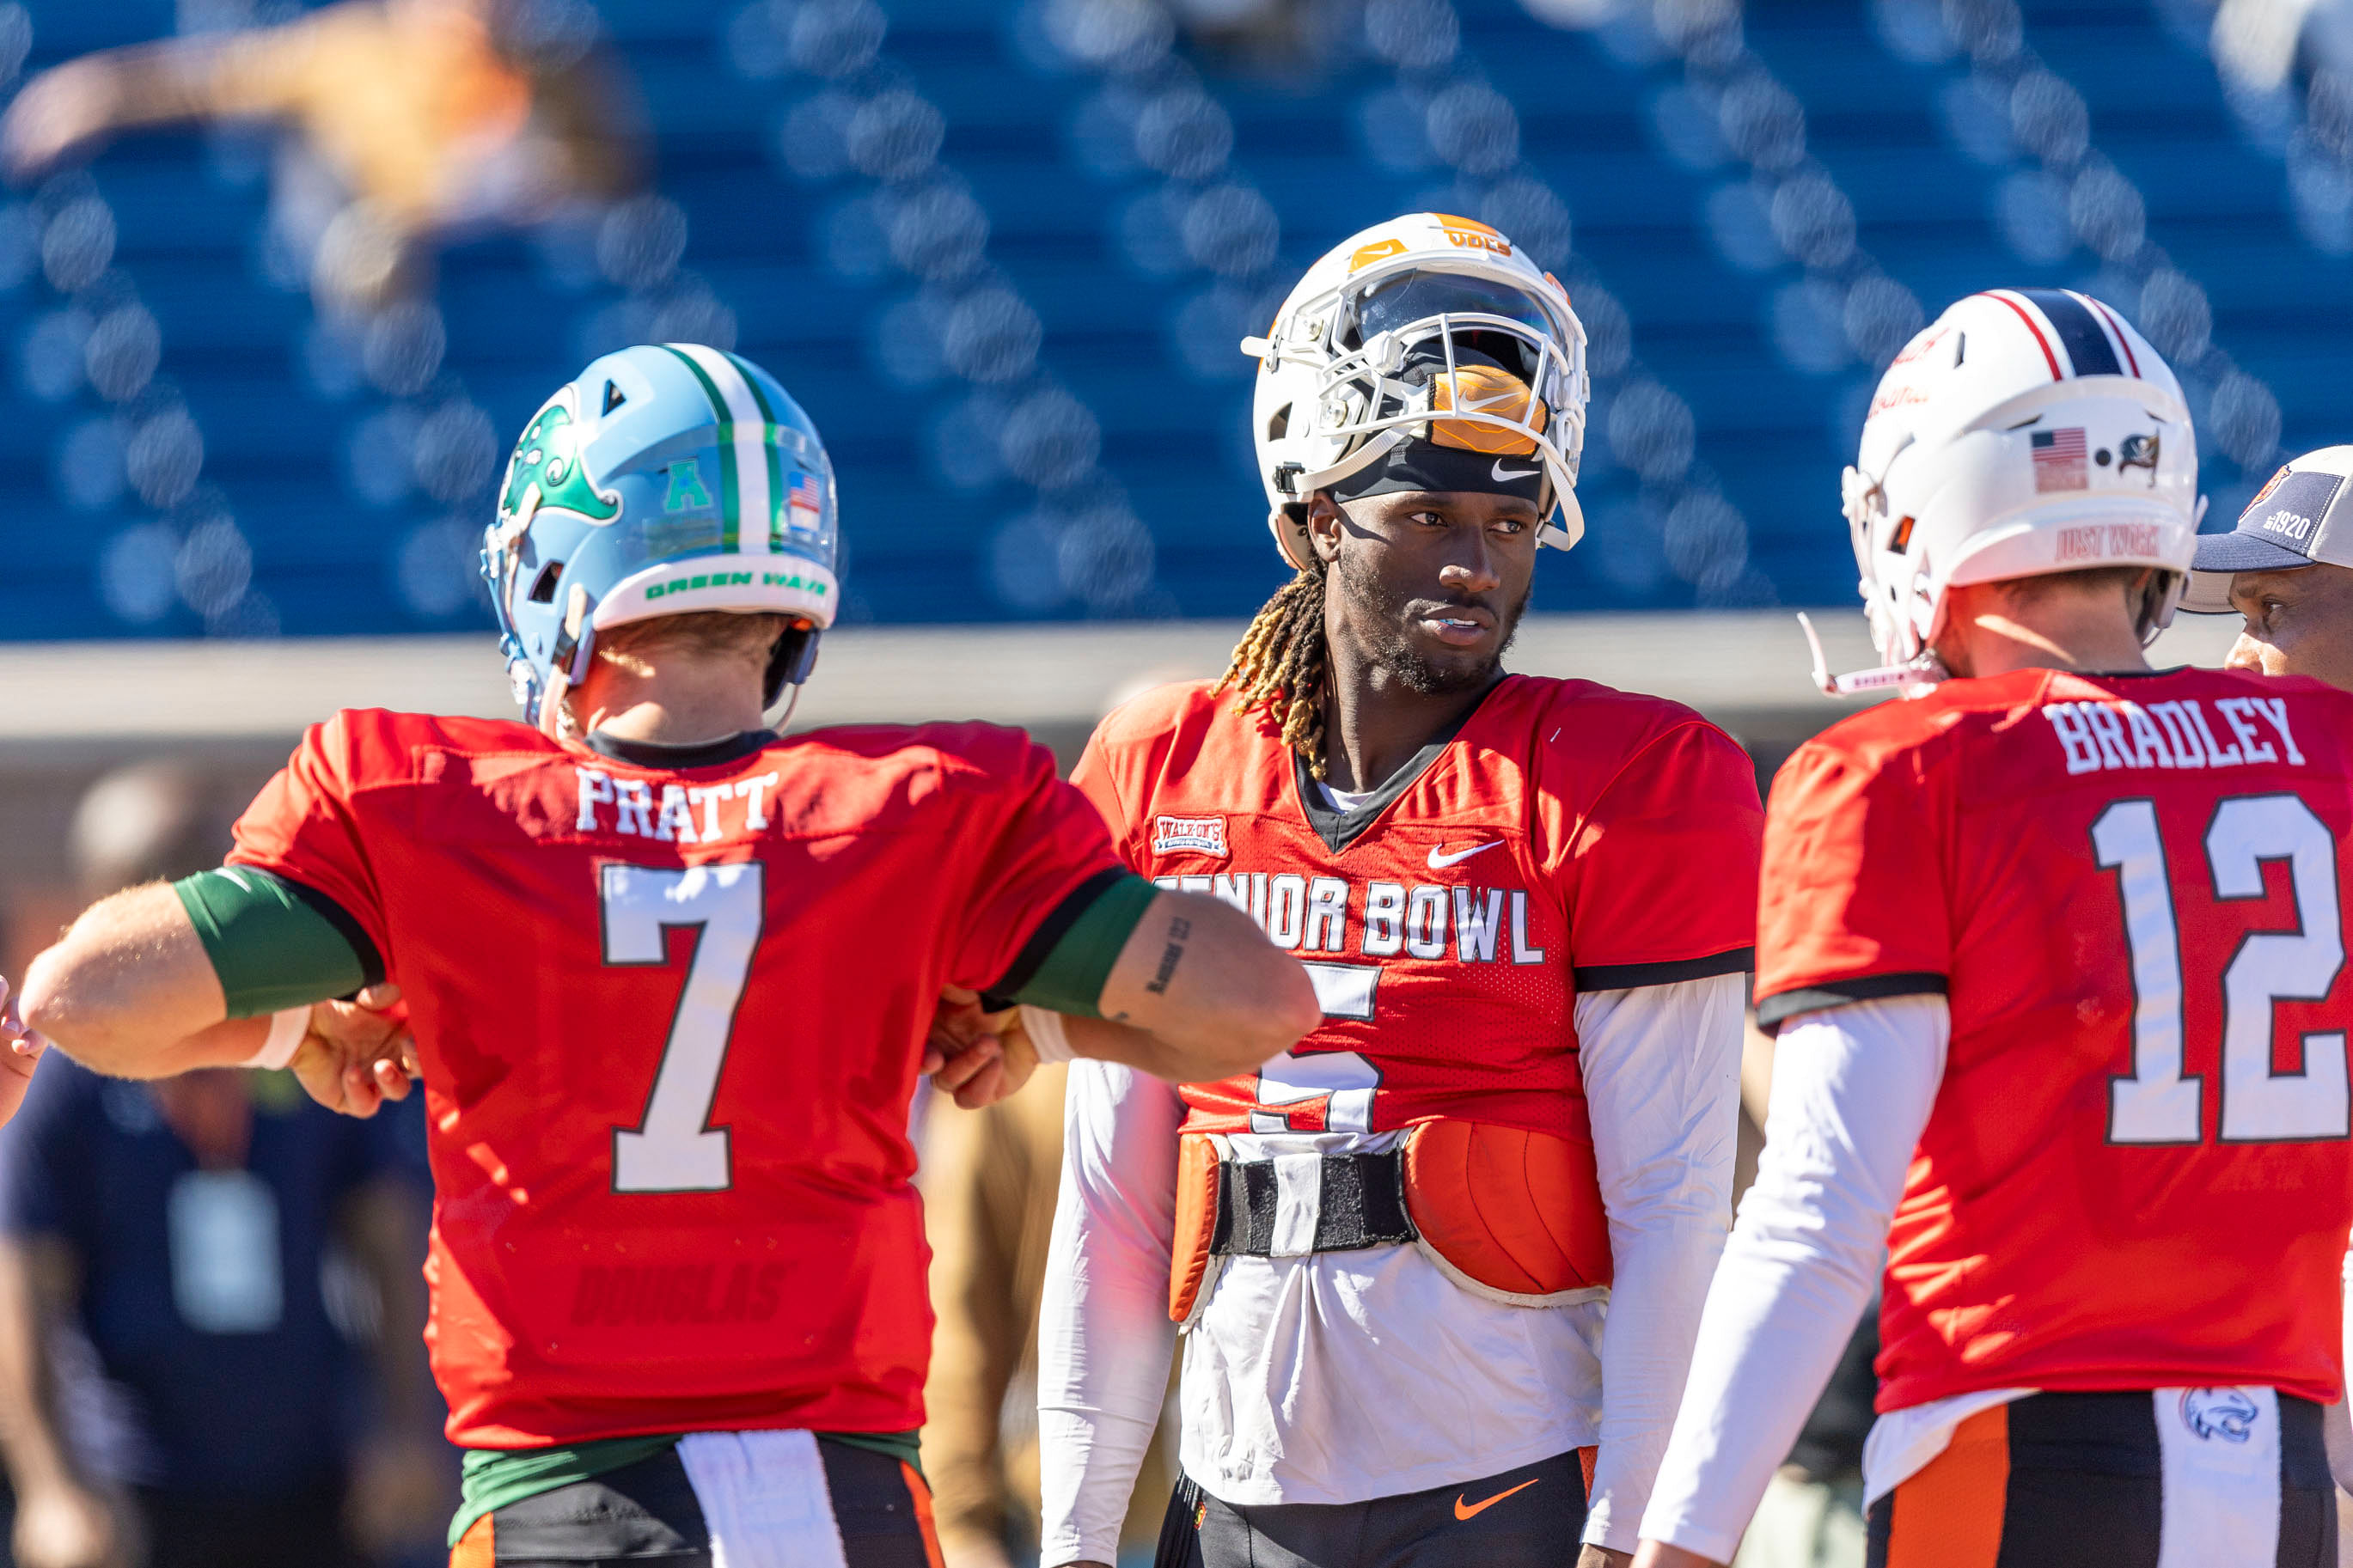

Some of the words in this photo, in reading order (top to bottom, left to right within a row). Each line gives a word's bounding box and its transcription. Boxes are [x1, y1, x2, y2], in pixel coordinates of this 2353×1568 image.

[1445, 229, 1512, 256] VOLS
[2055, 525, 2105, 564] JUST
[2109, 523, 2160, 558] WORK
[2271, 509, 2311, 540] 1920
[645, 571, 753, 600] GREEN
[2042, 698, 2306, 775] BRADLEY
[575, 767, 779, 844] PRATT
[1152, 872, 1349, 952] NIOR
[1360, 881, 1545, 966] BOWL
[2088, 792, 2351, 1144] 12
[602, 861, 766, 1193] 7
[570, 1262, 792, 1327] DOUGLAS
